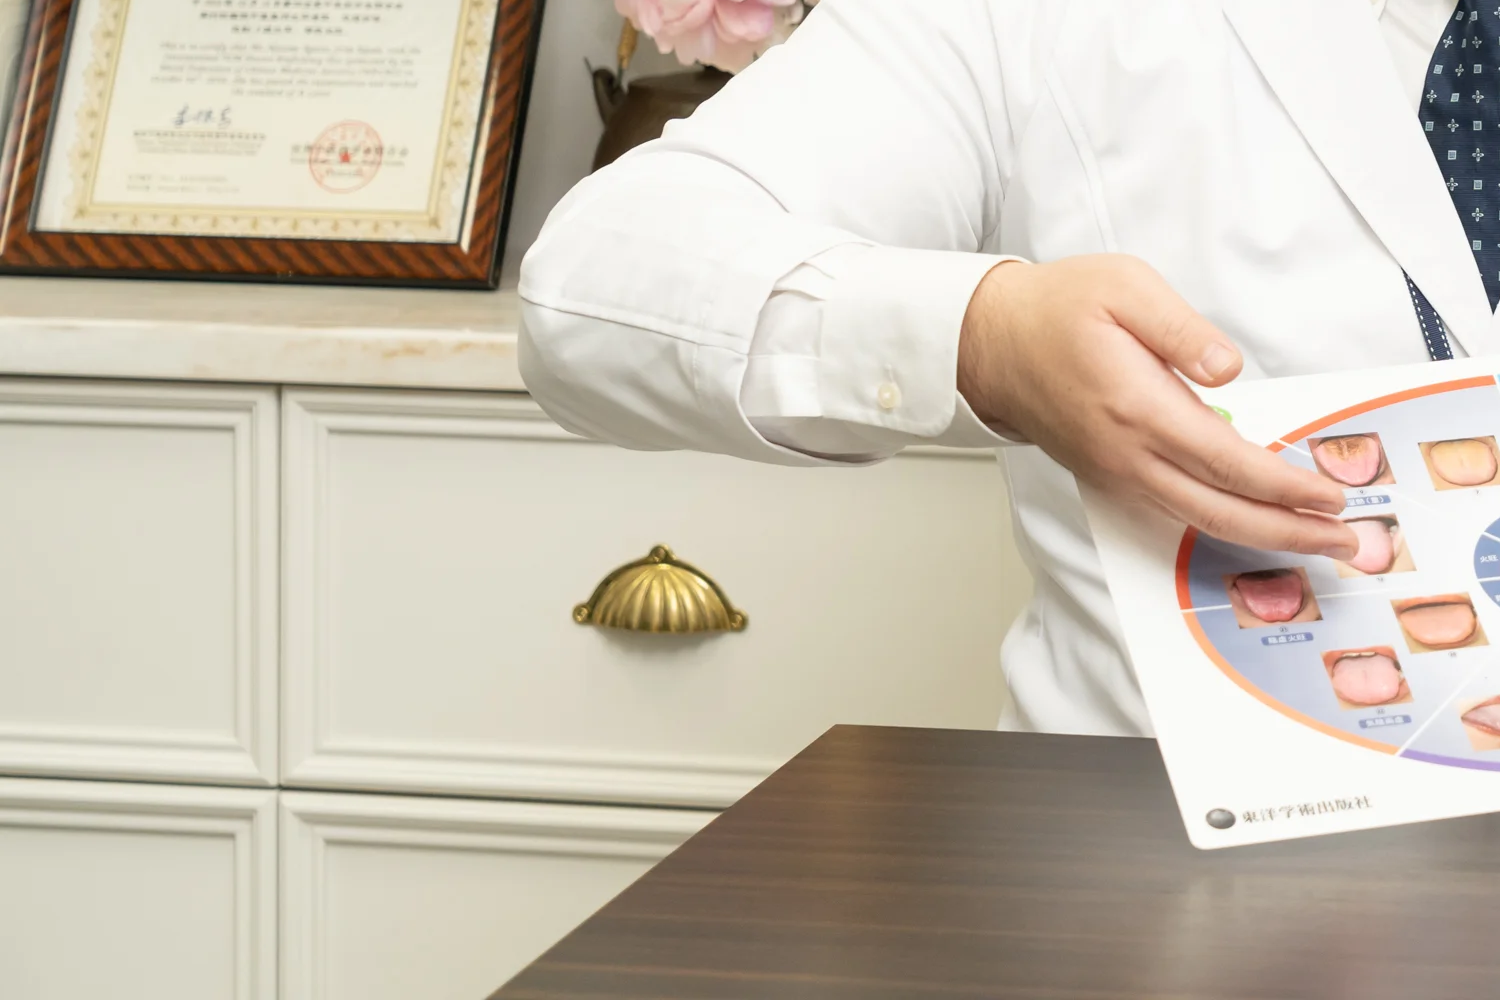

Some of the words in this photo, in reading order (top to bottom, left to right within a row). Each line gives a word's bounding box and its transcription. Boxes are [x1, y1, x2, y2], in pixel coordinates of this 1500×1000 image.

[1242, 795, 1373, 823] 東洋学術出版社
